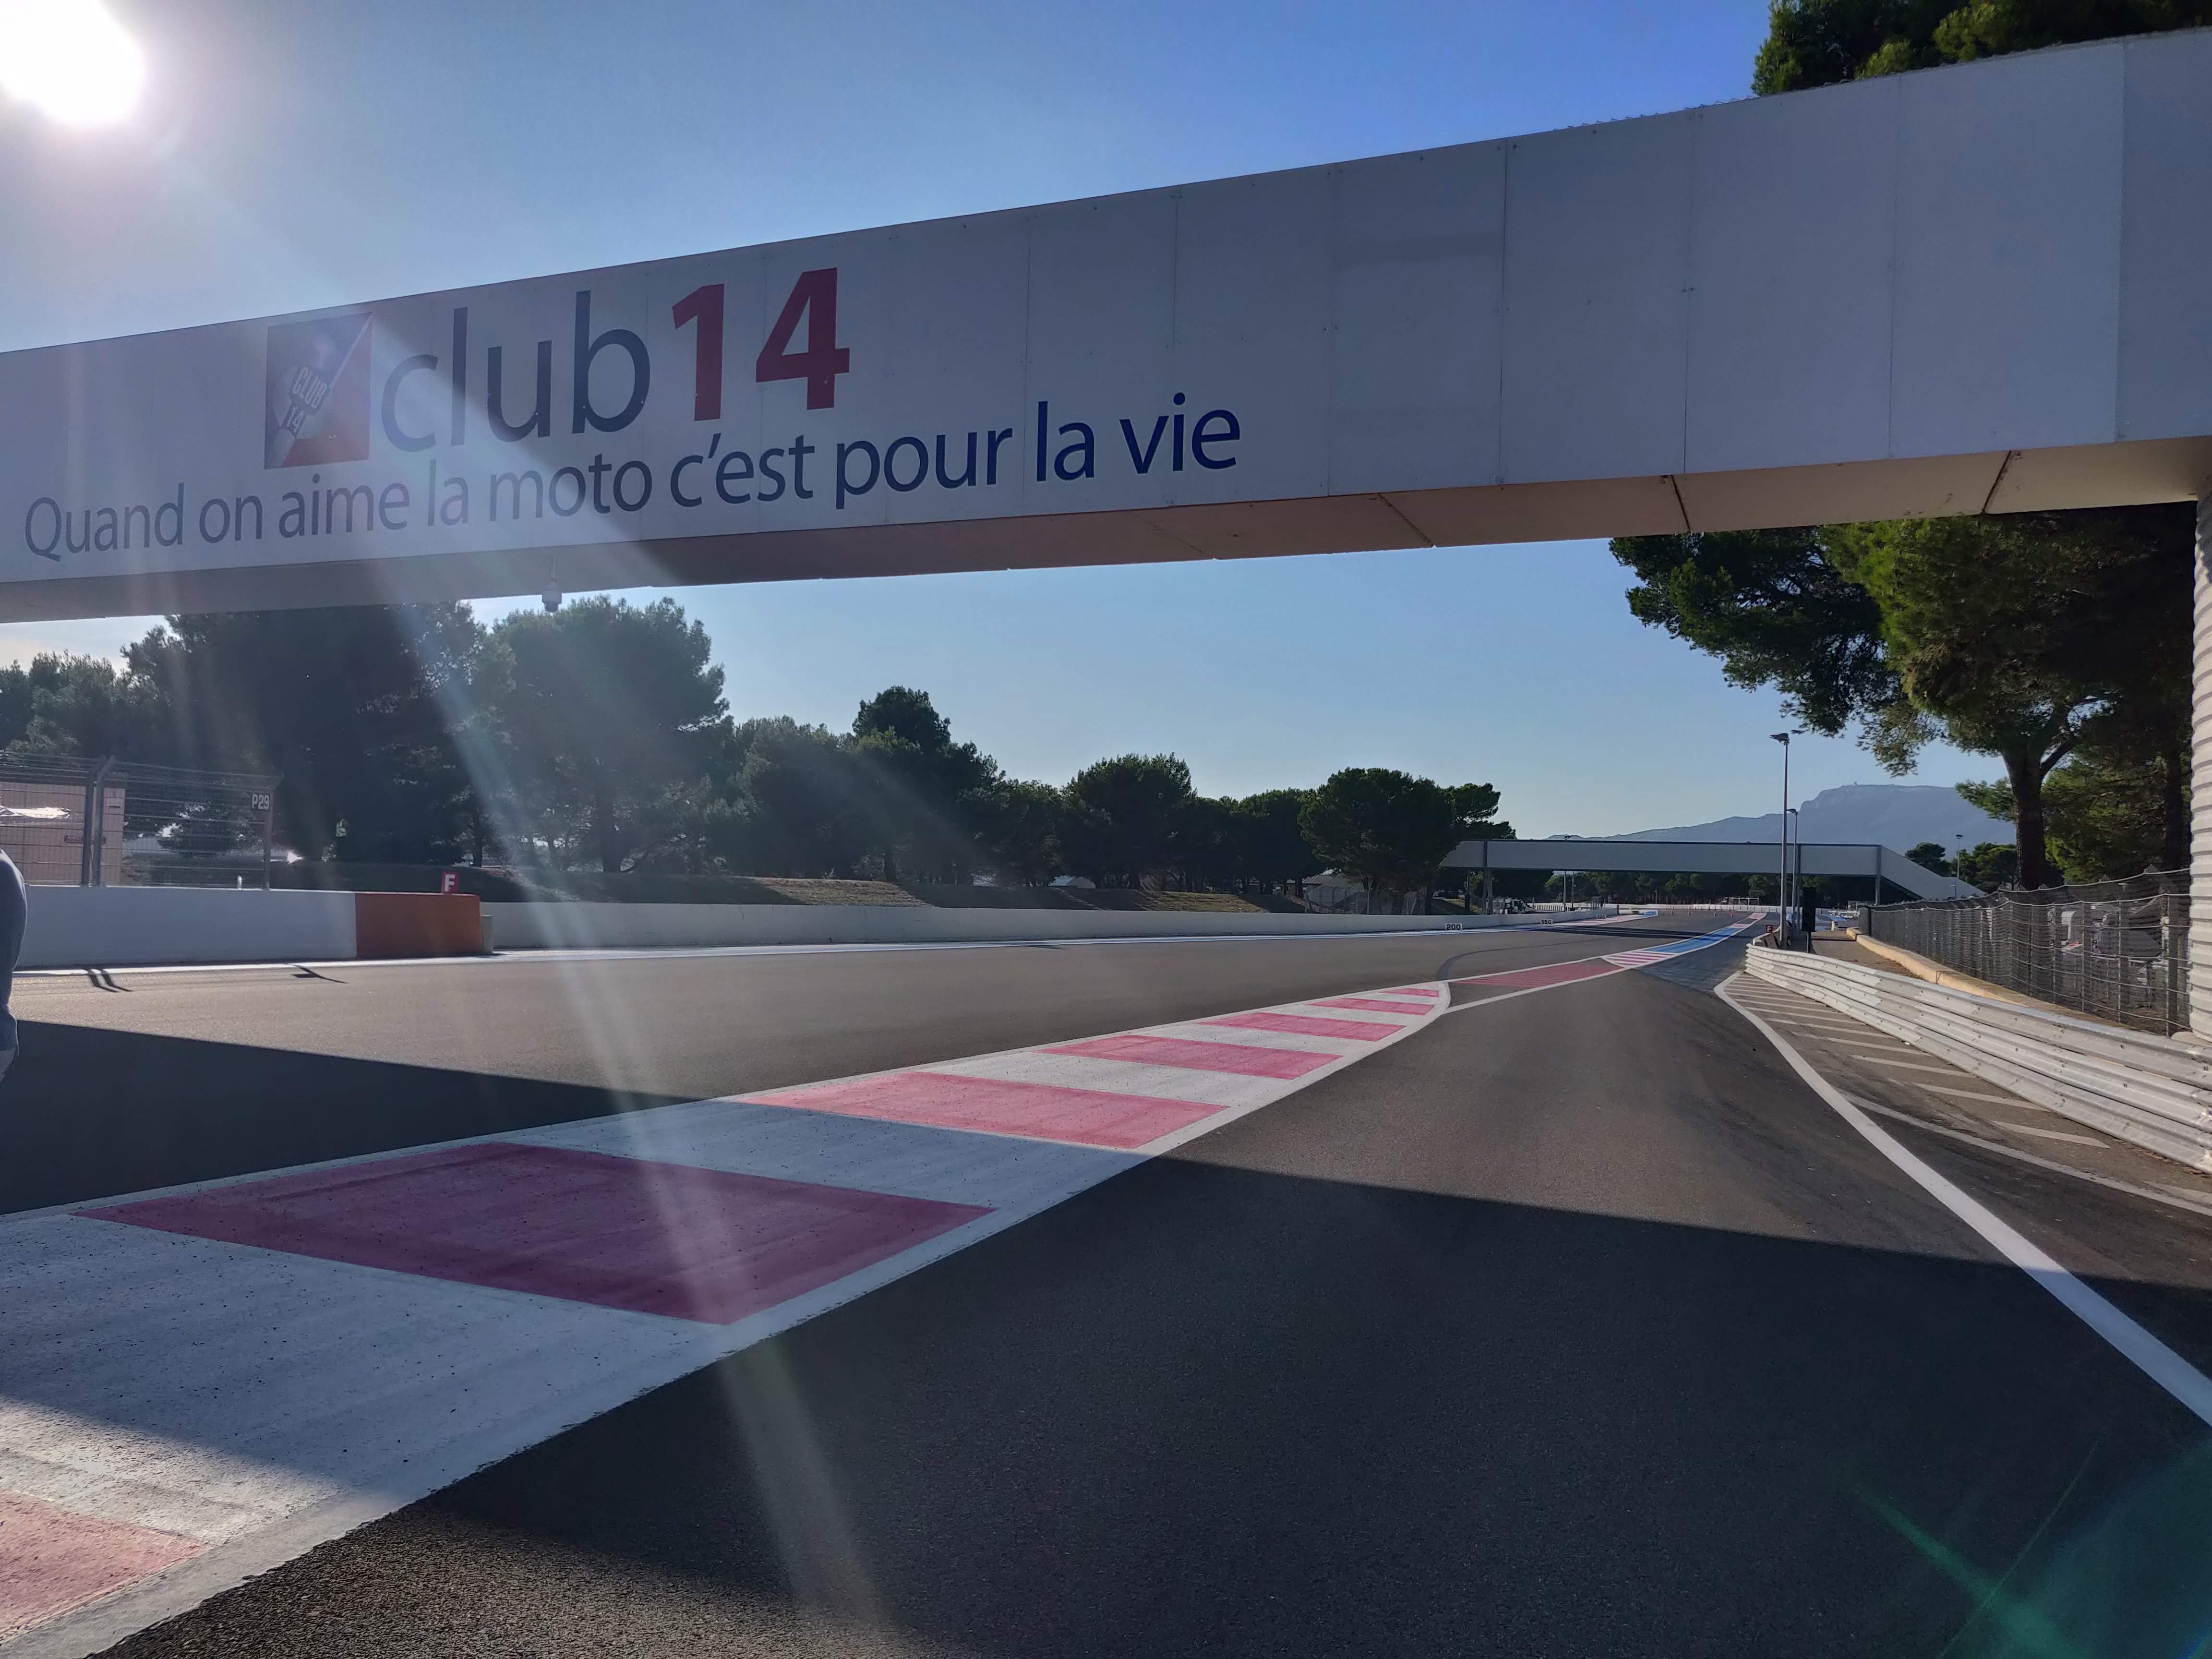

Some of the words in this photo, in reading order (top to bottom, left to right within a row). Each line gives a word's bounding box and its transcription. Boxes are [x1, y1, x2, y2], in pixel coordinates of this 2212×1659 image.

[292, 366, 328, 409] CLUB
[288, 407, 304, 433] 14
[25, 482, 185, 562] Quand
[199, 494, 263, 543] on
[279, 473, 410, 538] aime
[428, 460, 469, 527] la
[489, 454, 652, 521] moto
[670, 433, 815, 507] c'est
[836, 428, 1013, 510] pour
[1036, 401, 1095, 482] la
[1119, 392, 1240, 474] vie
[252, 794, 269, 810] P29
[445, 874, 456, 891] F
